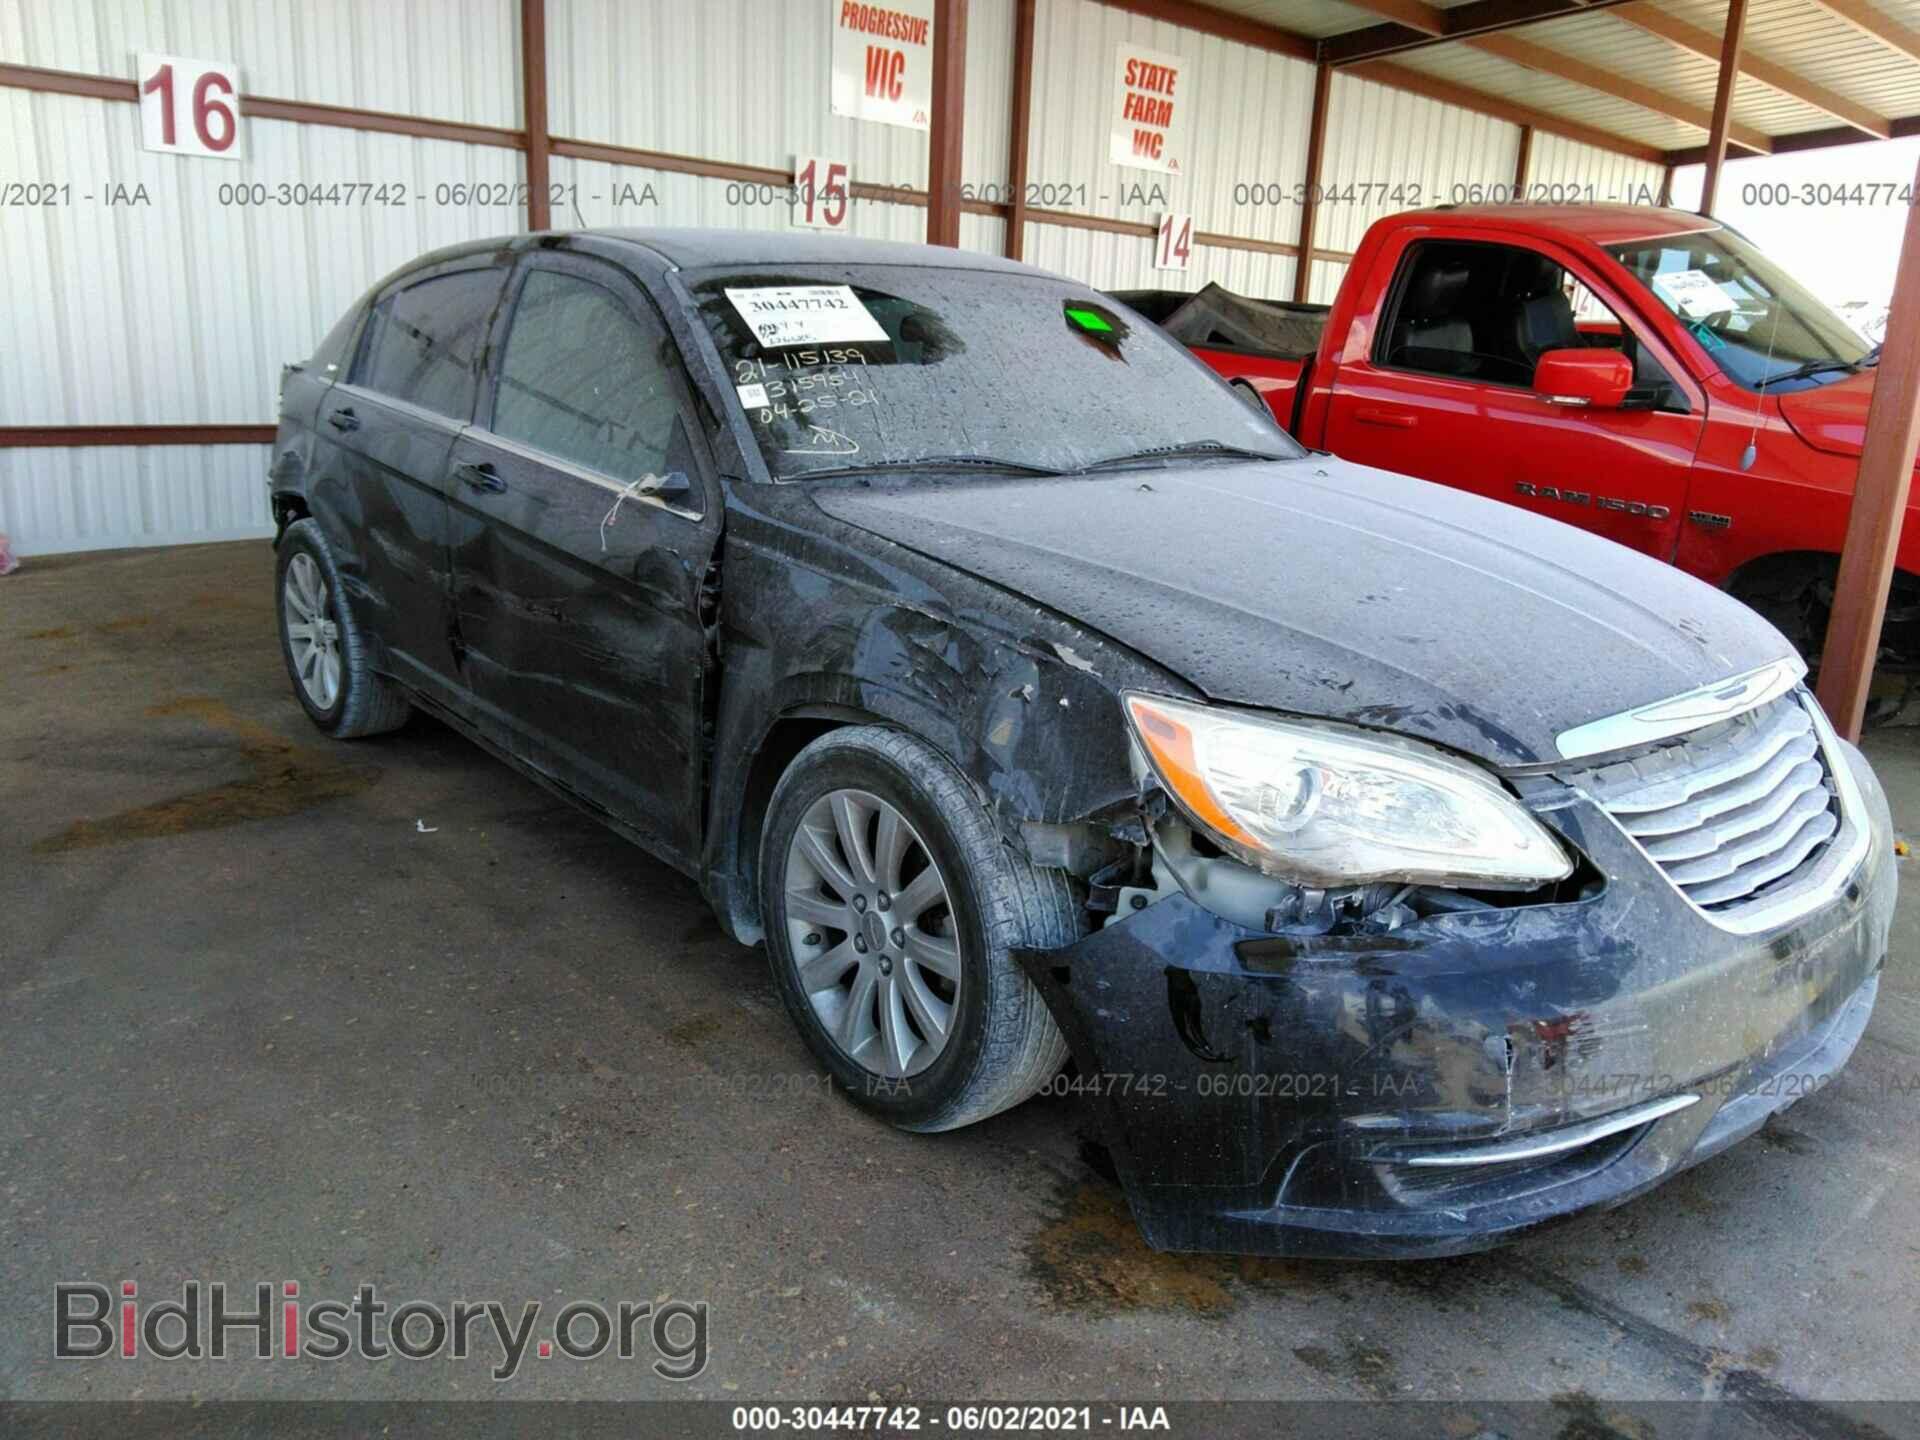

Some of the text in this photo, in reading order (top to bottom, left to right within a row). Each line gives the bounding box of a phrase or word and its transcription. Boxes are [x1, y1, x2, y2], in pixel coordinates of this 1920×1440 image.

[840, 1, 929, 46] PROGRESSIVE
[865, 44, 905, 102] VIC
[1125, 57, 1178, 96] STATE
[143, 63, 237, 152] 16
[1123, 92, 1174, 128] FARM
[1132, 128, 1164, 161] VIC
[799, 159, 848, 226] 15
[1161, 214, 1192, 268] 14
[749, 298, 849, 313] 30447742
[735, 348, 867, 384] 21-115139
[765, 369, 862, 398] 315954
[760, 389, 880, 424] 04-25-21
[1515, 480, 1671, 521] RAM 1500
